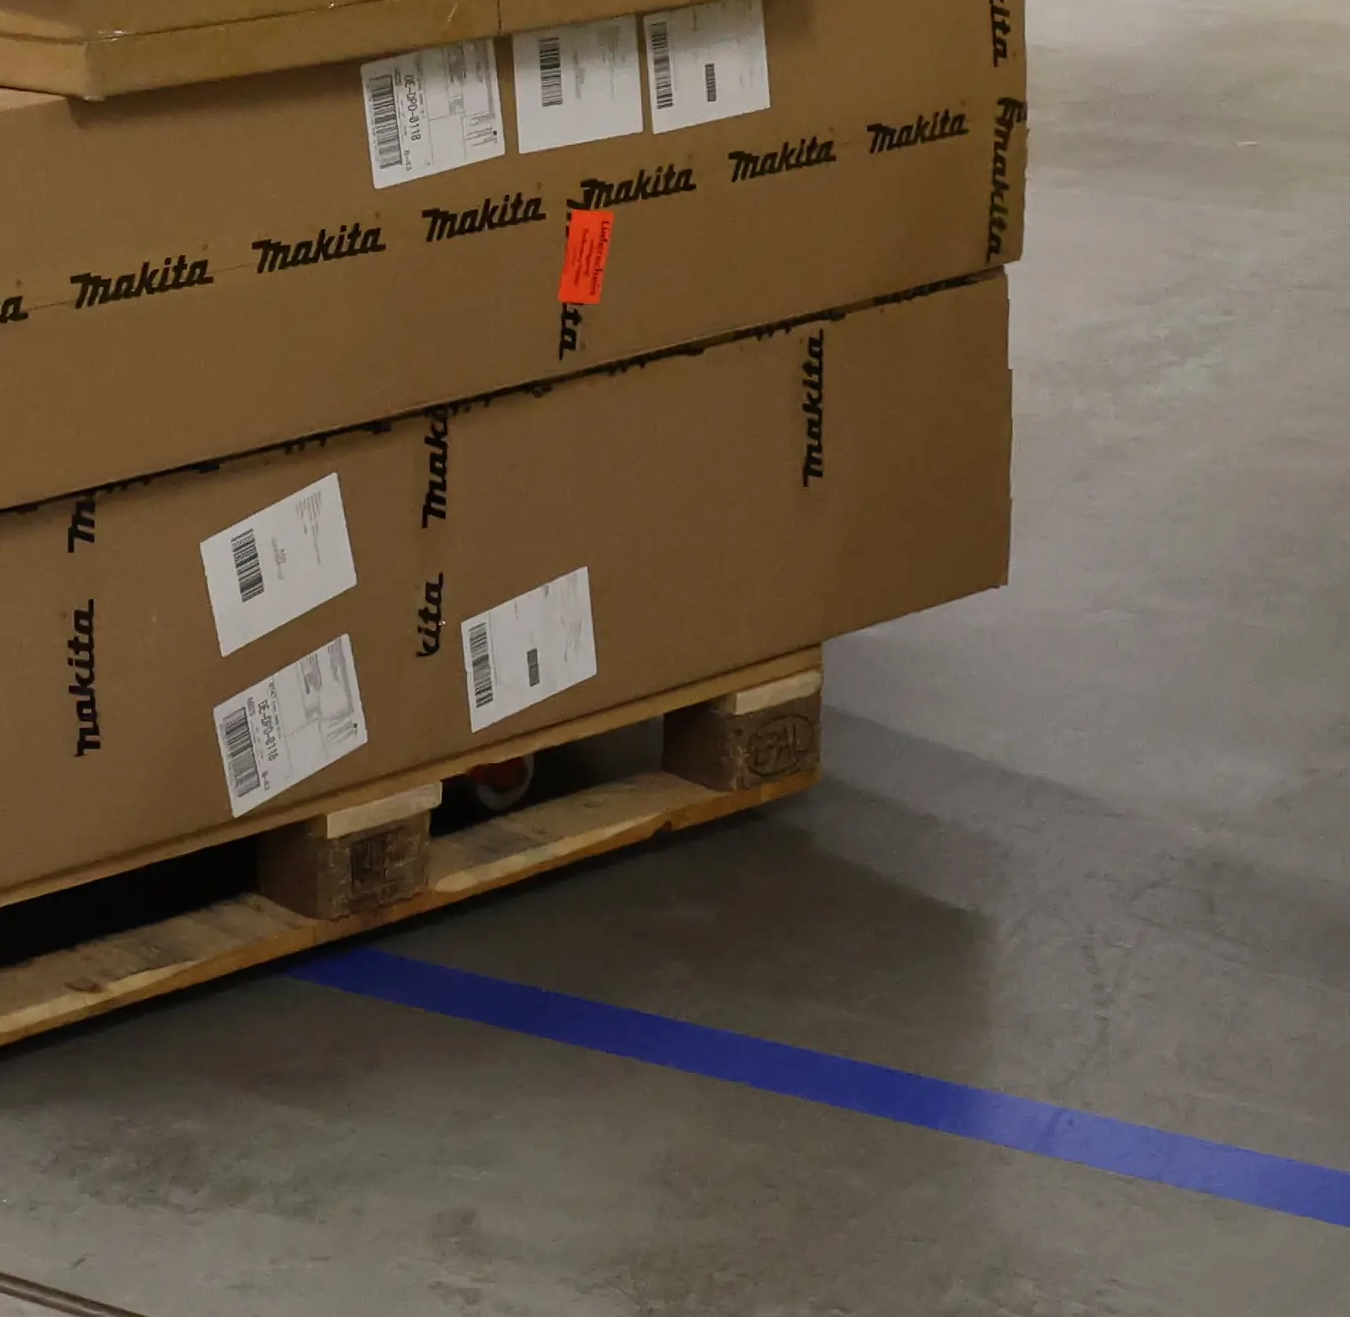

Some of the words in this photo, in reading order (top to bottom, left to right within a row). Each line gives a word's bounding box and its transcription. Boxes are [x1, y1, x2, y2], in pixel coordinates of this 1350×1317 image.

[864, 108, 970, 154] makita
[727, 135, 837, 183] makita
[580, 164, 697, 211] makita
[421, 192, 547, 242] makita
[251, 222, 387, 274] makita
[69, 254, 215, 309] makita
[802, 329, 824, 488] makita
